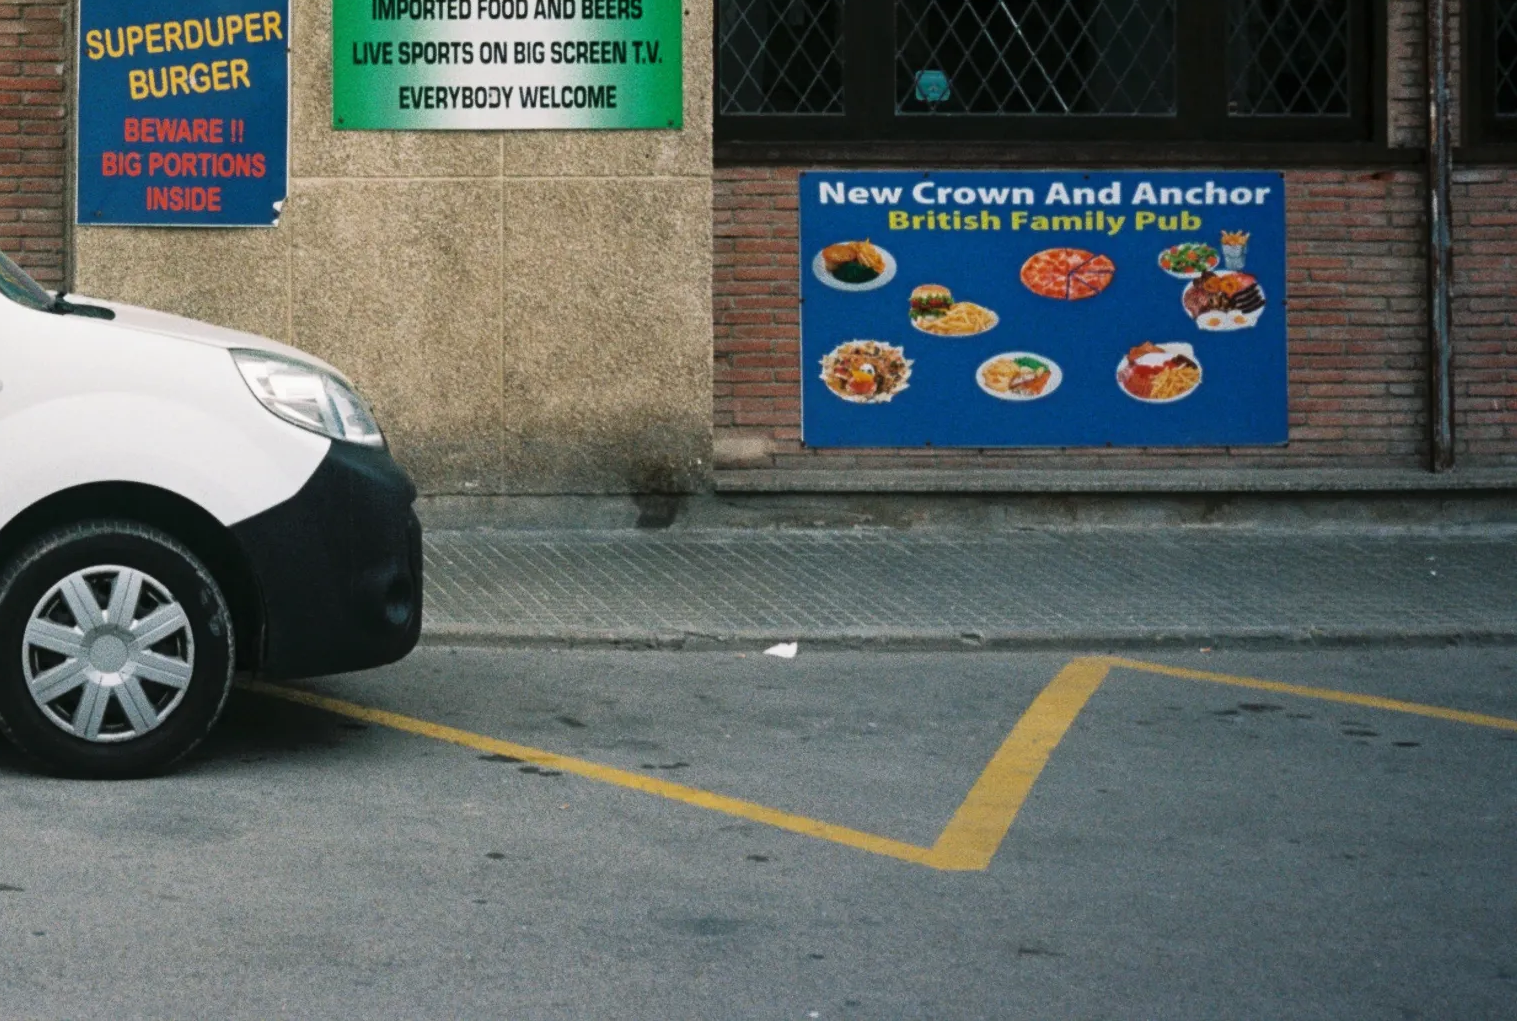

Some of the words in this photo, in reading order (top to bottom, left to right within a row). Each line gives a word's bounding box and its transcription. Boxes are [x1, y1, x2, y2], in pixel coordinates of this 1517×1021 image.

[86, 10, 283, 60] SUPERDUPER
[352, 41, 393, 65] LIVE
[398, 42, 474, 65] SPORTS
[479, 42, 508, 64] ON
[514, 42, 545, 64] BIG
[550, 41, 627, 64] SCREEN
[633, 41, 663, 64] T.V.
[128, 58, 251, 100] BURGER
[399, 86, 514, 109] EVERYBODY
[519, 86, 617, 108] WELCOME
[124, 118, 224, 143] BEWARE
[231, 119, 244, 143] !!
[101, 152, 142, 177] BIG
[148, 153, 266, 178] PORTIONS
[146, 186, 222, 212] INSIDE
[818, 182, 903, 206] New
[912, 182, 1035, 206] Crown
[1045, 181, 1122, 206] And
[1132, 181, 1271, 206] Anchor
[888, 210, 1001, 231] British
[1011, 210, 1126, 235] Family
[1135, 209, 1203, 231] Pub
